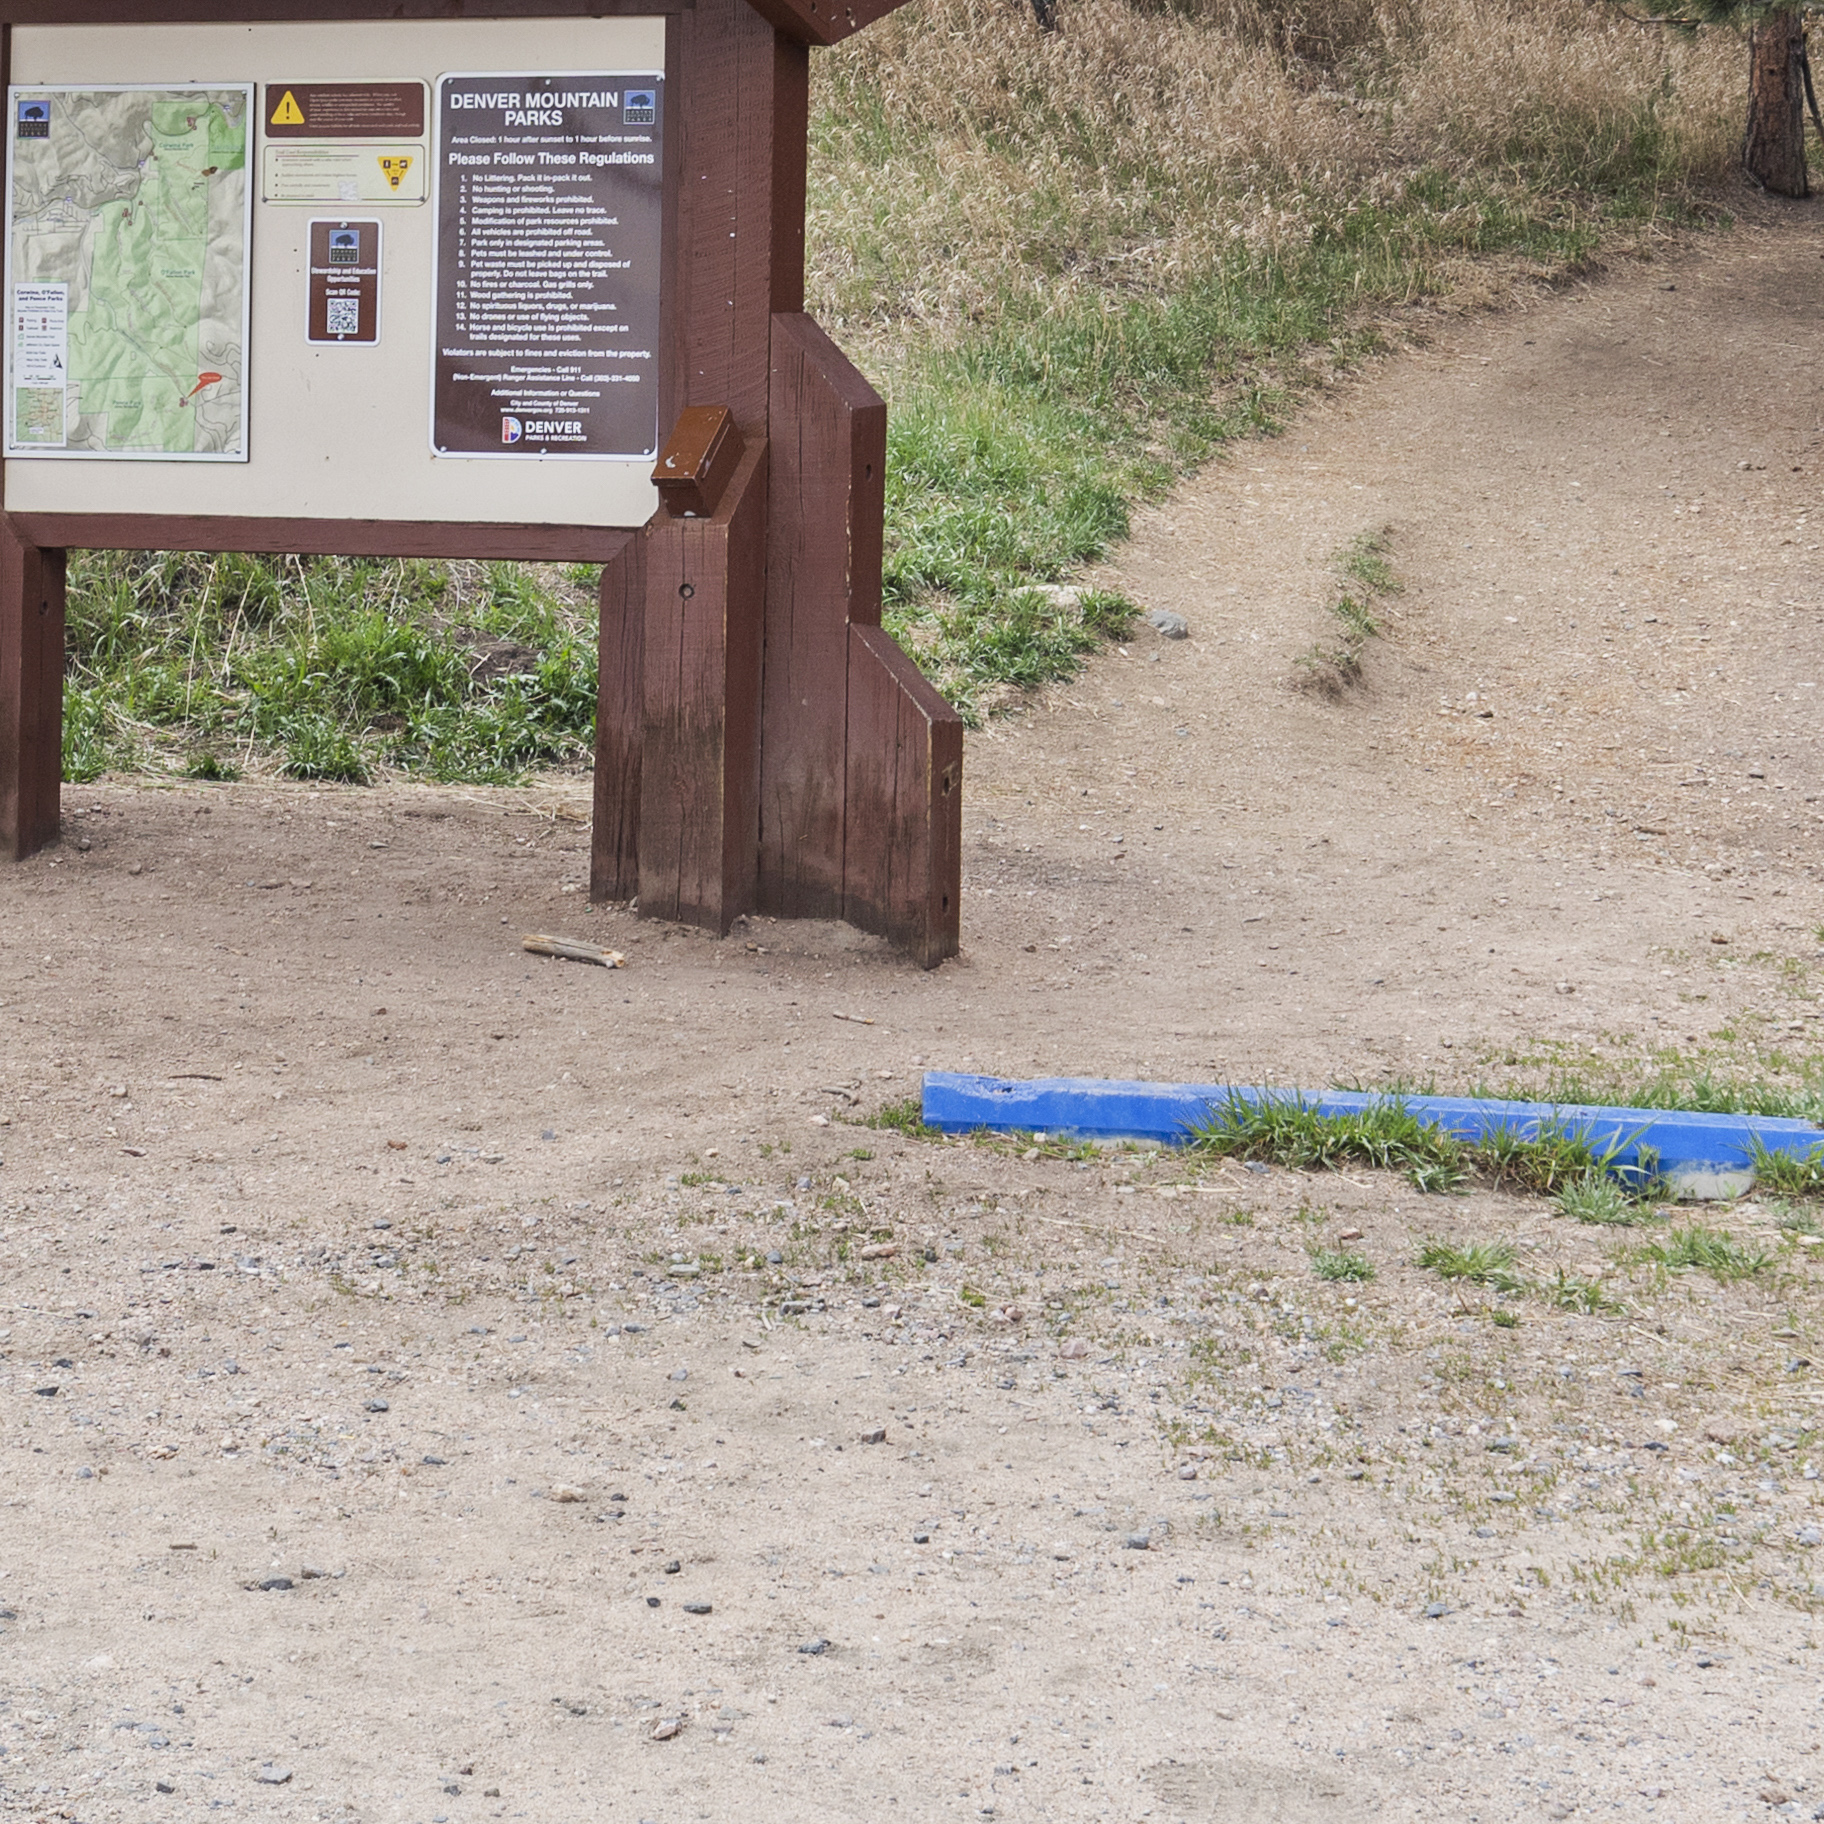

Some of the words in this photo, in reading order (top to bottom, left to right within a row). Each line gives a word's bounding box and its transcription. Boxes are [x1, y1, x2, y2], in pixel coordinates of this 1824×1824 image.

[451, 93, 520, 109] DENVER
[526, 92, 618, 108] MOUNTAIN
[505, 111, 563, 126] PARKS
[451, 136, 468, 144] Area
[504, 136, 520, 144] hour
[522, 136, 538, 144] after
[540, 136, 564, 144] sunset
[566, 136, 573, 144] to
[581, 135, 597, 143] hour
[599, 135, 622, 143] before
[449, 153, 490, 165] Please
[494, 153, 535, 165] Follow
[538, 152, 576, 165] These
[579, 152, 654, 167] Regulations
[460, 185, 467, 193] 2.
[472, 185, 483, 193] No
[484, 185, 511, 193] hunting
[522, 185, 554, 194] shooting.
[460, 196, 466, 204] 3.
[472, 196, 505, 204] Weapons
[506, 196, 520, 204] and
[521, 196, 554, 204] fireworks
[556, 196, 594, 204] prohibited.
[472, 207, 504, 215] Camping
[513, 207, 550, 215] prohibited.
[459, 228, 466, 236] 6.
[471, 228, 481, 236] All
[482, 228, 511, 236] vehicles
[526, 228, 562, 237] prohibited
[563, 228, 573, 236] off
[574, 228, 593, 236] road.
[459, 239, 466, 247] 7.
[471, 239, 487, 247] Park
[489, 239, 504, 248] only
[506, 239, 512, 247] in
[514, 239, 553, 248] designated
[555, 239, 581, 248] parking
[537, 261, 561, 269] picked
[588, 261, 621, 269] disposed
[471, 270, 501, 278] properly.
[549, 270, 566, 278] bags
[558, 281, 575, 289] grills
[577, 281, 594, 289] only.
[492, 292, 526, 300] gathering
[540, 313, 559, 321] flying
[561, 313, 589, 321] objects.
[443, 348, 473, 356] Violators
[488, 349, 514, 358] subject
[588, 349, 604, 357] from
[606, 349, 618, 357] the
[619, 350, 651, 359] property.
[525, 421, 582, 433] DENVER
